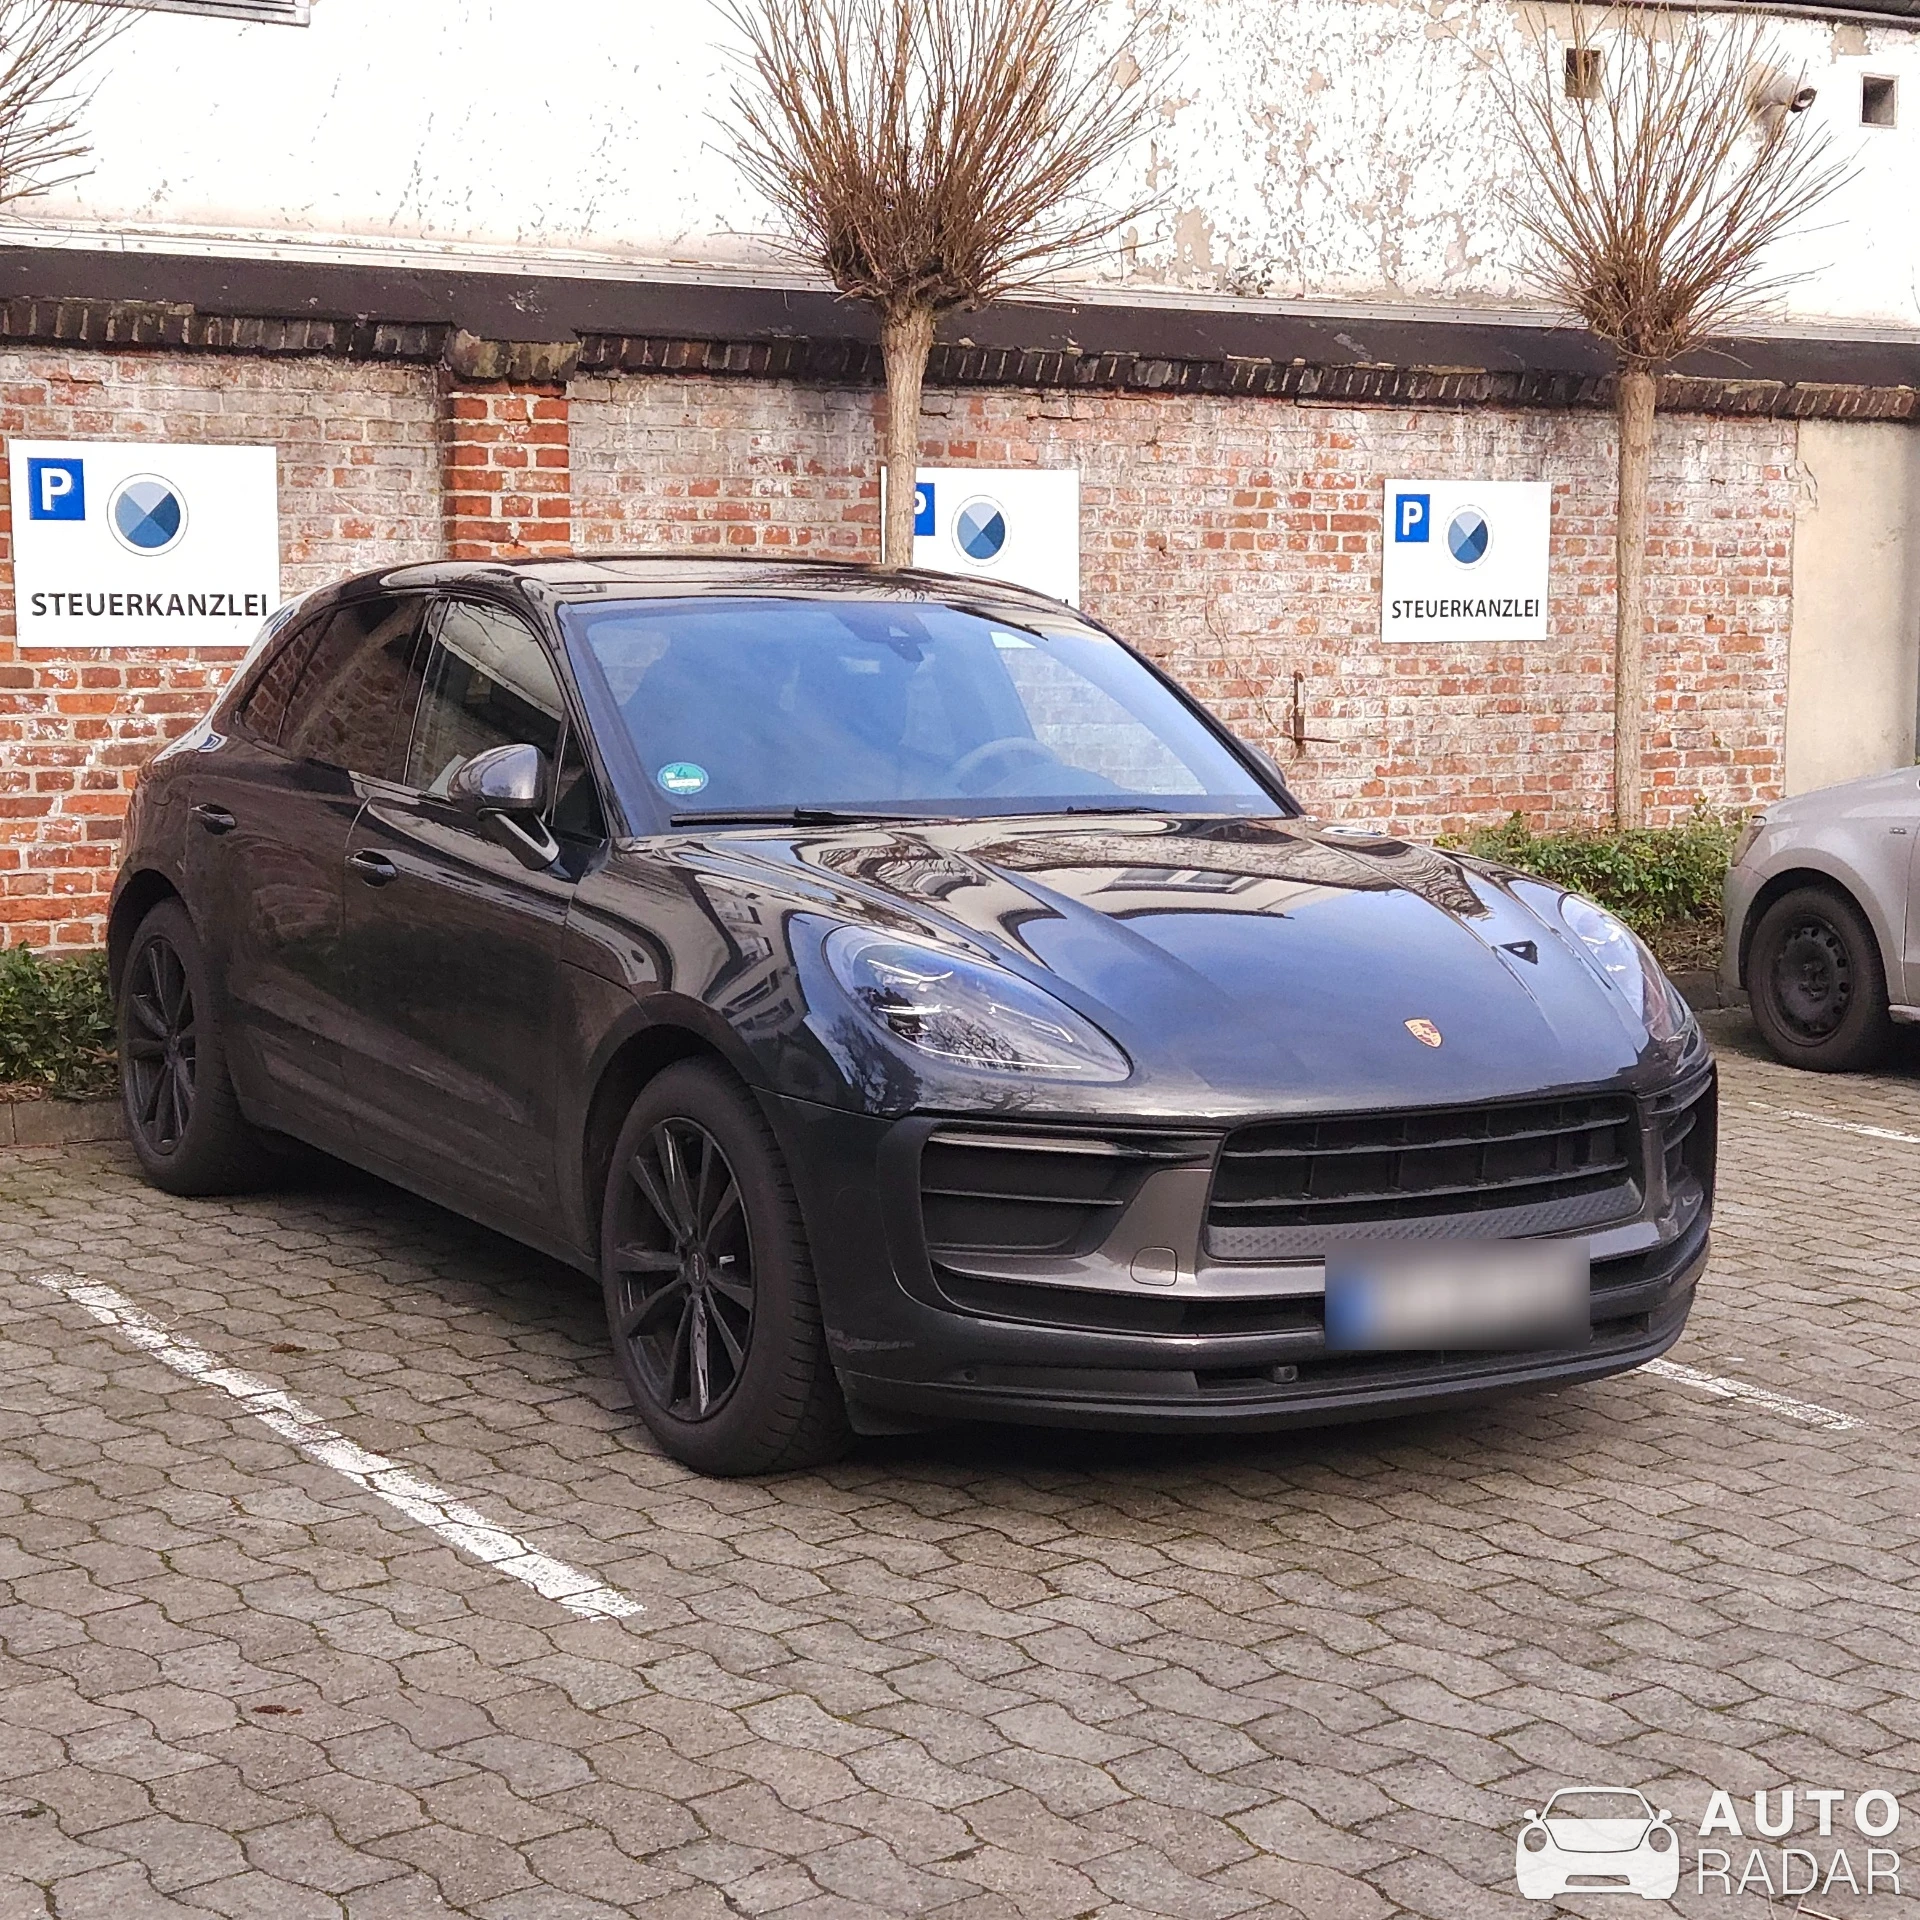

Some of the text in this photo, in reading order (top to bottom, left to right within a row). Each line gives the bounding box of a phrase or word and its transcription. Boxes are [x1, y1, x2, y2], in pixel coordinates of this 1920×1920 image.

[40, 467, 73, 511] P
[1402, 501, 1423, 536] P
[31, 593, 267, 616] STEUERKANZLEI
[1392, 599, 1539, 618] STEUERKANZLEI
